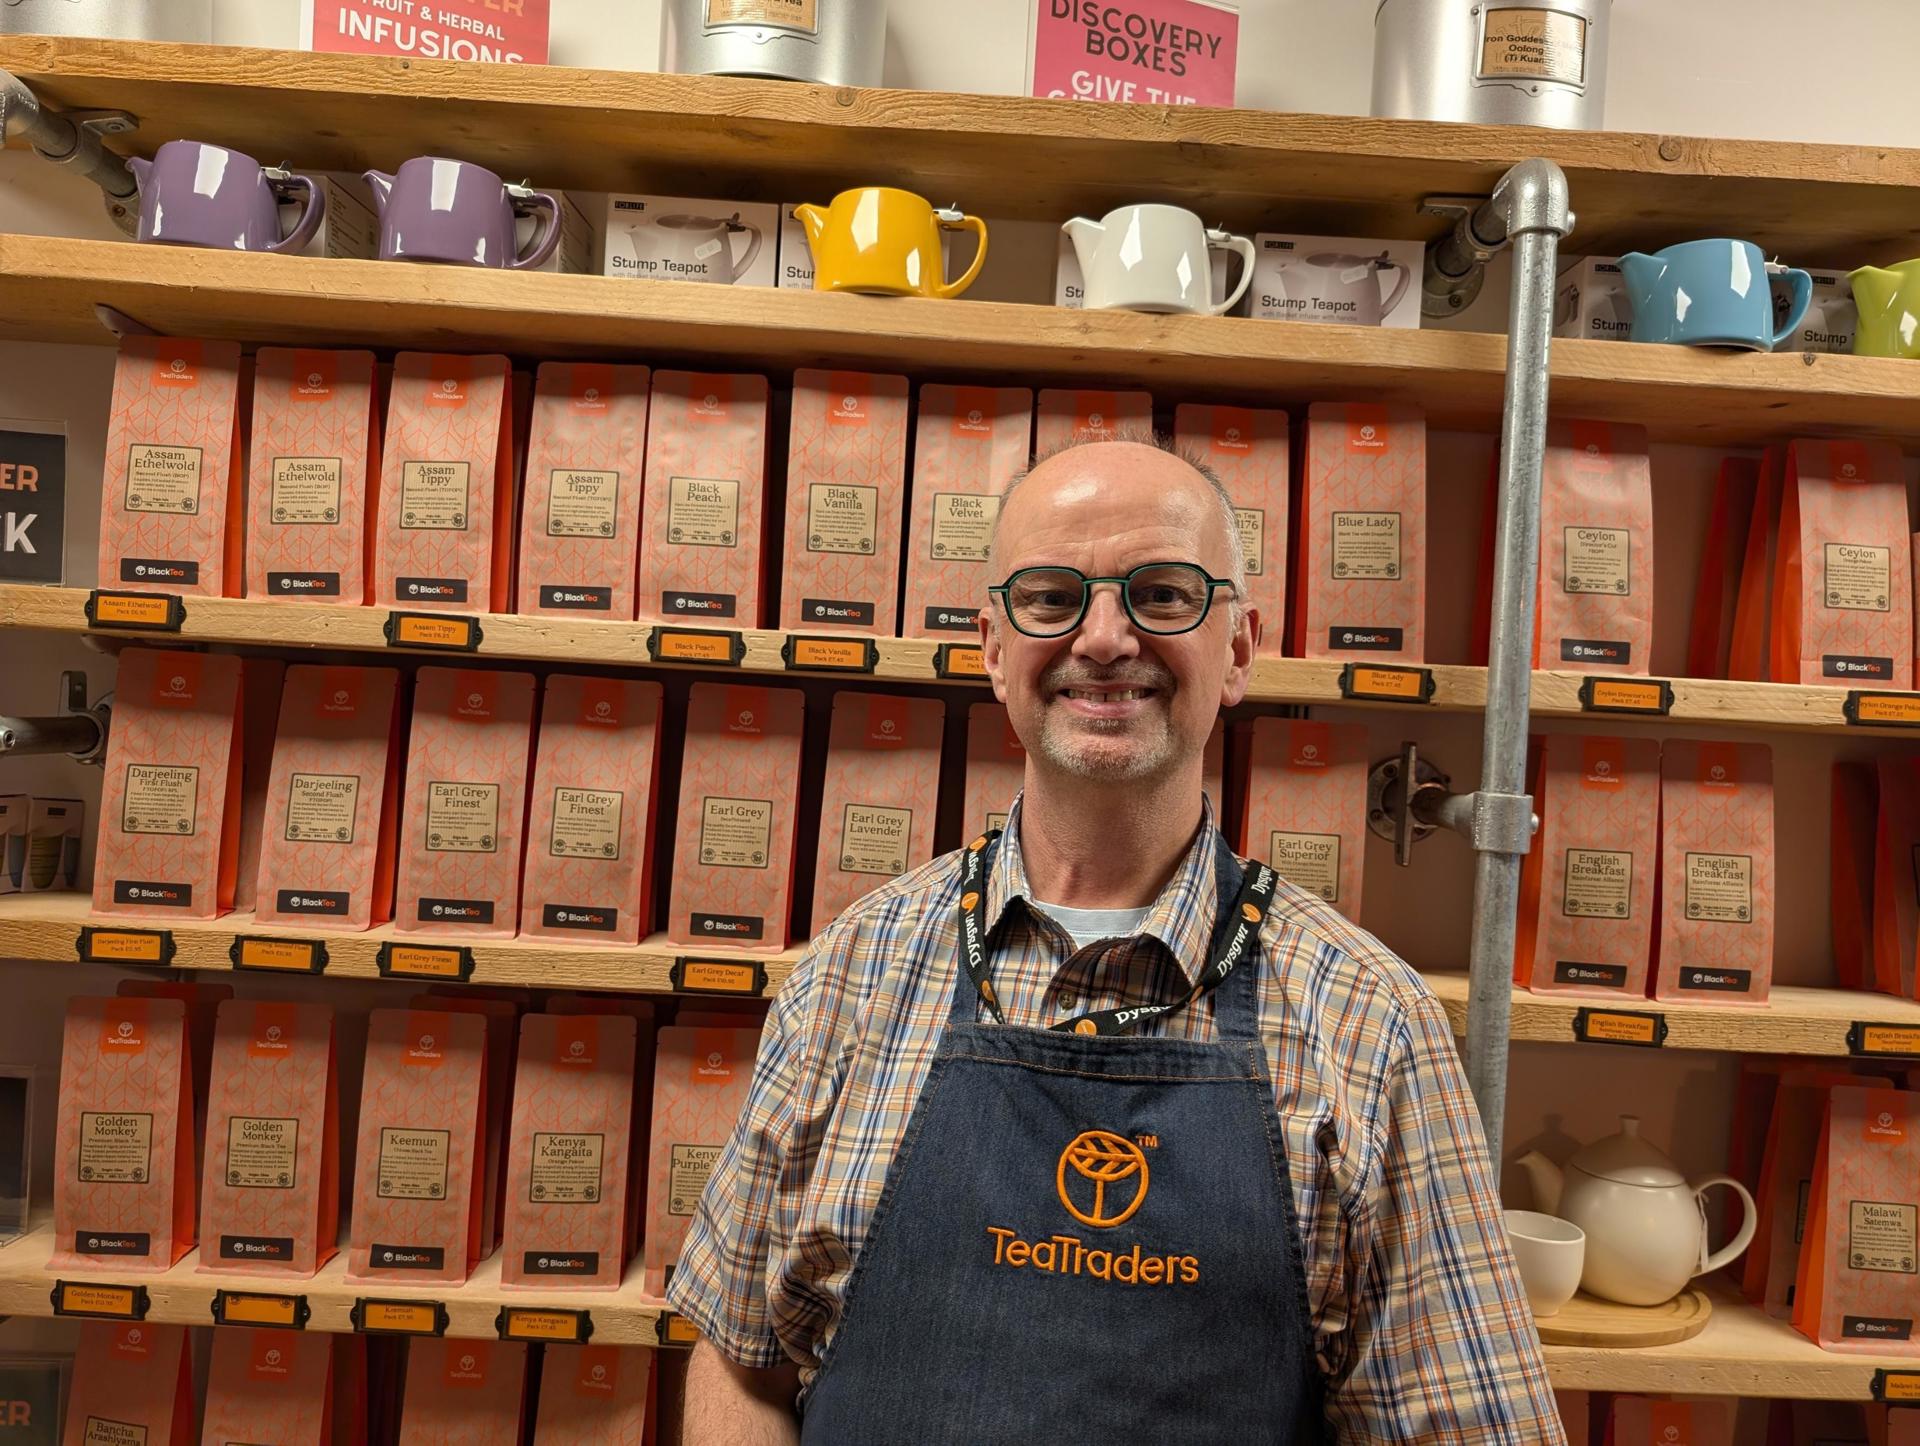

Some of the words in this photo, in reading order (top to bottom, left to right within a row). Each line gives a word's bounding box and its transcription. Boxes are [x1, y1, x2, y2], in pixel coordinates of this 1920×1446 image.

[362, 0, 414, 15] RUIT
[420, 5, 432, 21] &
[438, 10, 505, 41] HERBAL
[1051, 0, 1222, 59] DISCOVERY
[1506, 34, 1546, 43] Goddes
[1086, 28, 1187, 77] BOXES
[1508, 44, 1544, 55] Oolong
[1520, 55, 1546, 64] Kuan
[1071, 69, 1137, 104] GIVE
[612, 255, 657, 272] Stump
[661, 259, 708, 275] Teapot
[1065, 285, 1084, 298] St
[1261, 294, 1307, 311] Stump
[1311, 297, 1357, 314] Teapot
[1804, 329, 1847, 346] Stump
[144, 449, 185, 461] Assam
[134, 458, 195, 471] Ethelwold
[287, 462, 325, 472] Assam
[417, 465, 455, 475] Assam
[278, 471, 335, 482] Ethelwold
[420, 474, 451, 485] Tippy
[565, 474, 604, 484] Assam
[568, 483, 600, 495] Tippy
[688, 482, 720, 494] Black
[827, 488, 859, 500] Black
[687, 491, 722, 503] Peach
[951, 497, 982, 508] Black
[823, 498, 863, 510] Vanilla
[948, 507, 984, 518] Velvet
[1337, 517, 1364, 527] Blue
[1366, 517, 1395, 529] Lady
[3, 511, 38, 554] K
[1577, 530, 1616, 542] Ceylon
[1838, 547, 1876, 559] Ceylon
[148, 567, 184, 577] BlackTea
[292, 578, 326, 588] BlackTea
[420, 586, 454, 594] BlackTea
[564, 593, 598, 602] BlackTea
[687, 599, 722, 609] BlackTea
[827, 607, 861, 617] BlackTea
[950, 615, 979, 624] BlackTe
[1354, 634, 1389, 643] BlackTea
[1583, 647, 1616, 657] BlackTea
[1848, 663, 1880, 672] BlackTea
[131, 768, 192, 782] Darjeeling
[139, 779, 158, 787] First
[160, 779, 182, 788] Flush
[295, 779, 353, 793] Darjeeling
[301, 790, 325, 798] Second
[435, 786, 459, 796] Earl
[461, 787, 490, 800] Grey
[445, 797, 480, 808] Finest
[561, 792, 585, 803] Earl
[586, 793, 615, 807] Grey
[570, 803, 605, 816] Finest
[710, 804, 734, 816] Earl
[735, 806, 764, 820] Grey
[851, 812, 875, 824] Earl
[876, 814, 904, 827] Grey
[850, 823, 903, 837] Lavender
[1278, 838, 1301, 850] Earl
[1303, 840, 1333, 853] Grey
[1279, 849, 1330, 861] Superior
[1578, 853, 1619, 866] English
[1697, 857, 1738, 869] English
[1571, 863, 1625, 876] Breakfast
[1691, 867, 1744, 880] Breakfast
[141, 889, 177, 898] BlackTea
[302, 898, 336, 907] BlackTea
[444, 906, 480, 916] BlackTea
[568, 913, 604, 923] BlackTea
[715, 922, 750, 932] BlackTea
[965, 913, 982, 968] Dysgwr
[1216, 923, 1249, 978] Dysgwr
[1579, 970, 1613, 979] BlackTea
[1703, 975, 1738, 984] BlackTea
[95, 1116, 138, 1127] Golden
[243, 1120, 283, 1132] Golden
[94, 1126, 137, 1137] Monkey
[242, 1130, 283, 1143] Monkey
[390, 1134, 438, 1147] Keemun
[548, 1136, 586, 1149] Kenya
[1135, 1135, 1158, 1147] TM
[541, 1146, 593, 1159] Kangaita
[672, 1158, 710, 1172] Purple
[1863, 1206, 1902, 1218] Malawi
[1863, 1217, 1901, 1227] Satemwa
[100, 1239, 136, 1248] BlackTea
[245, 1244, 280, 1253] BlackTea
[395, 1253, 430, 1262] BlackTea
[986, 1226, 1200, 1285] TeaTraders
[550, 1259, 584, 1268] BlackTea
[1866, 1325, 1898, 1333] BlackTea
[96, 1421, 134, 1438] Bancha
